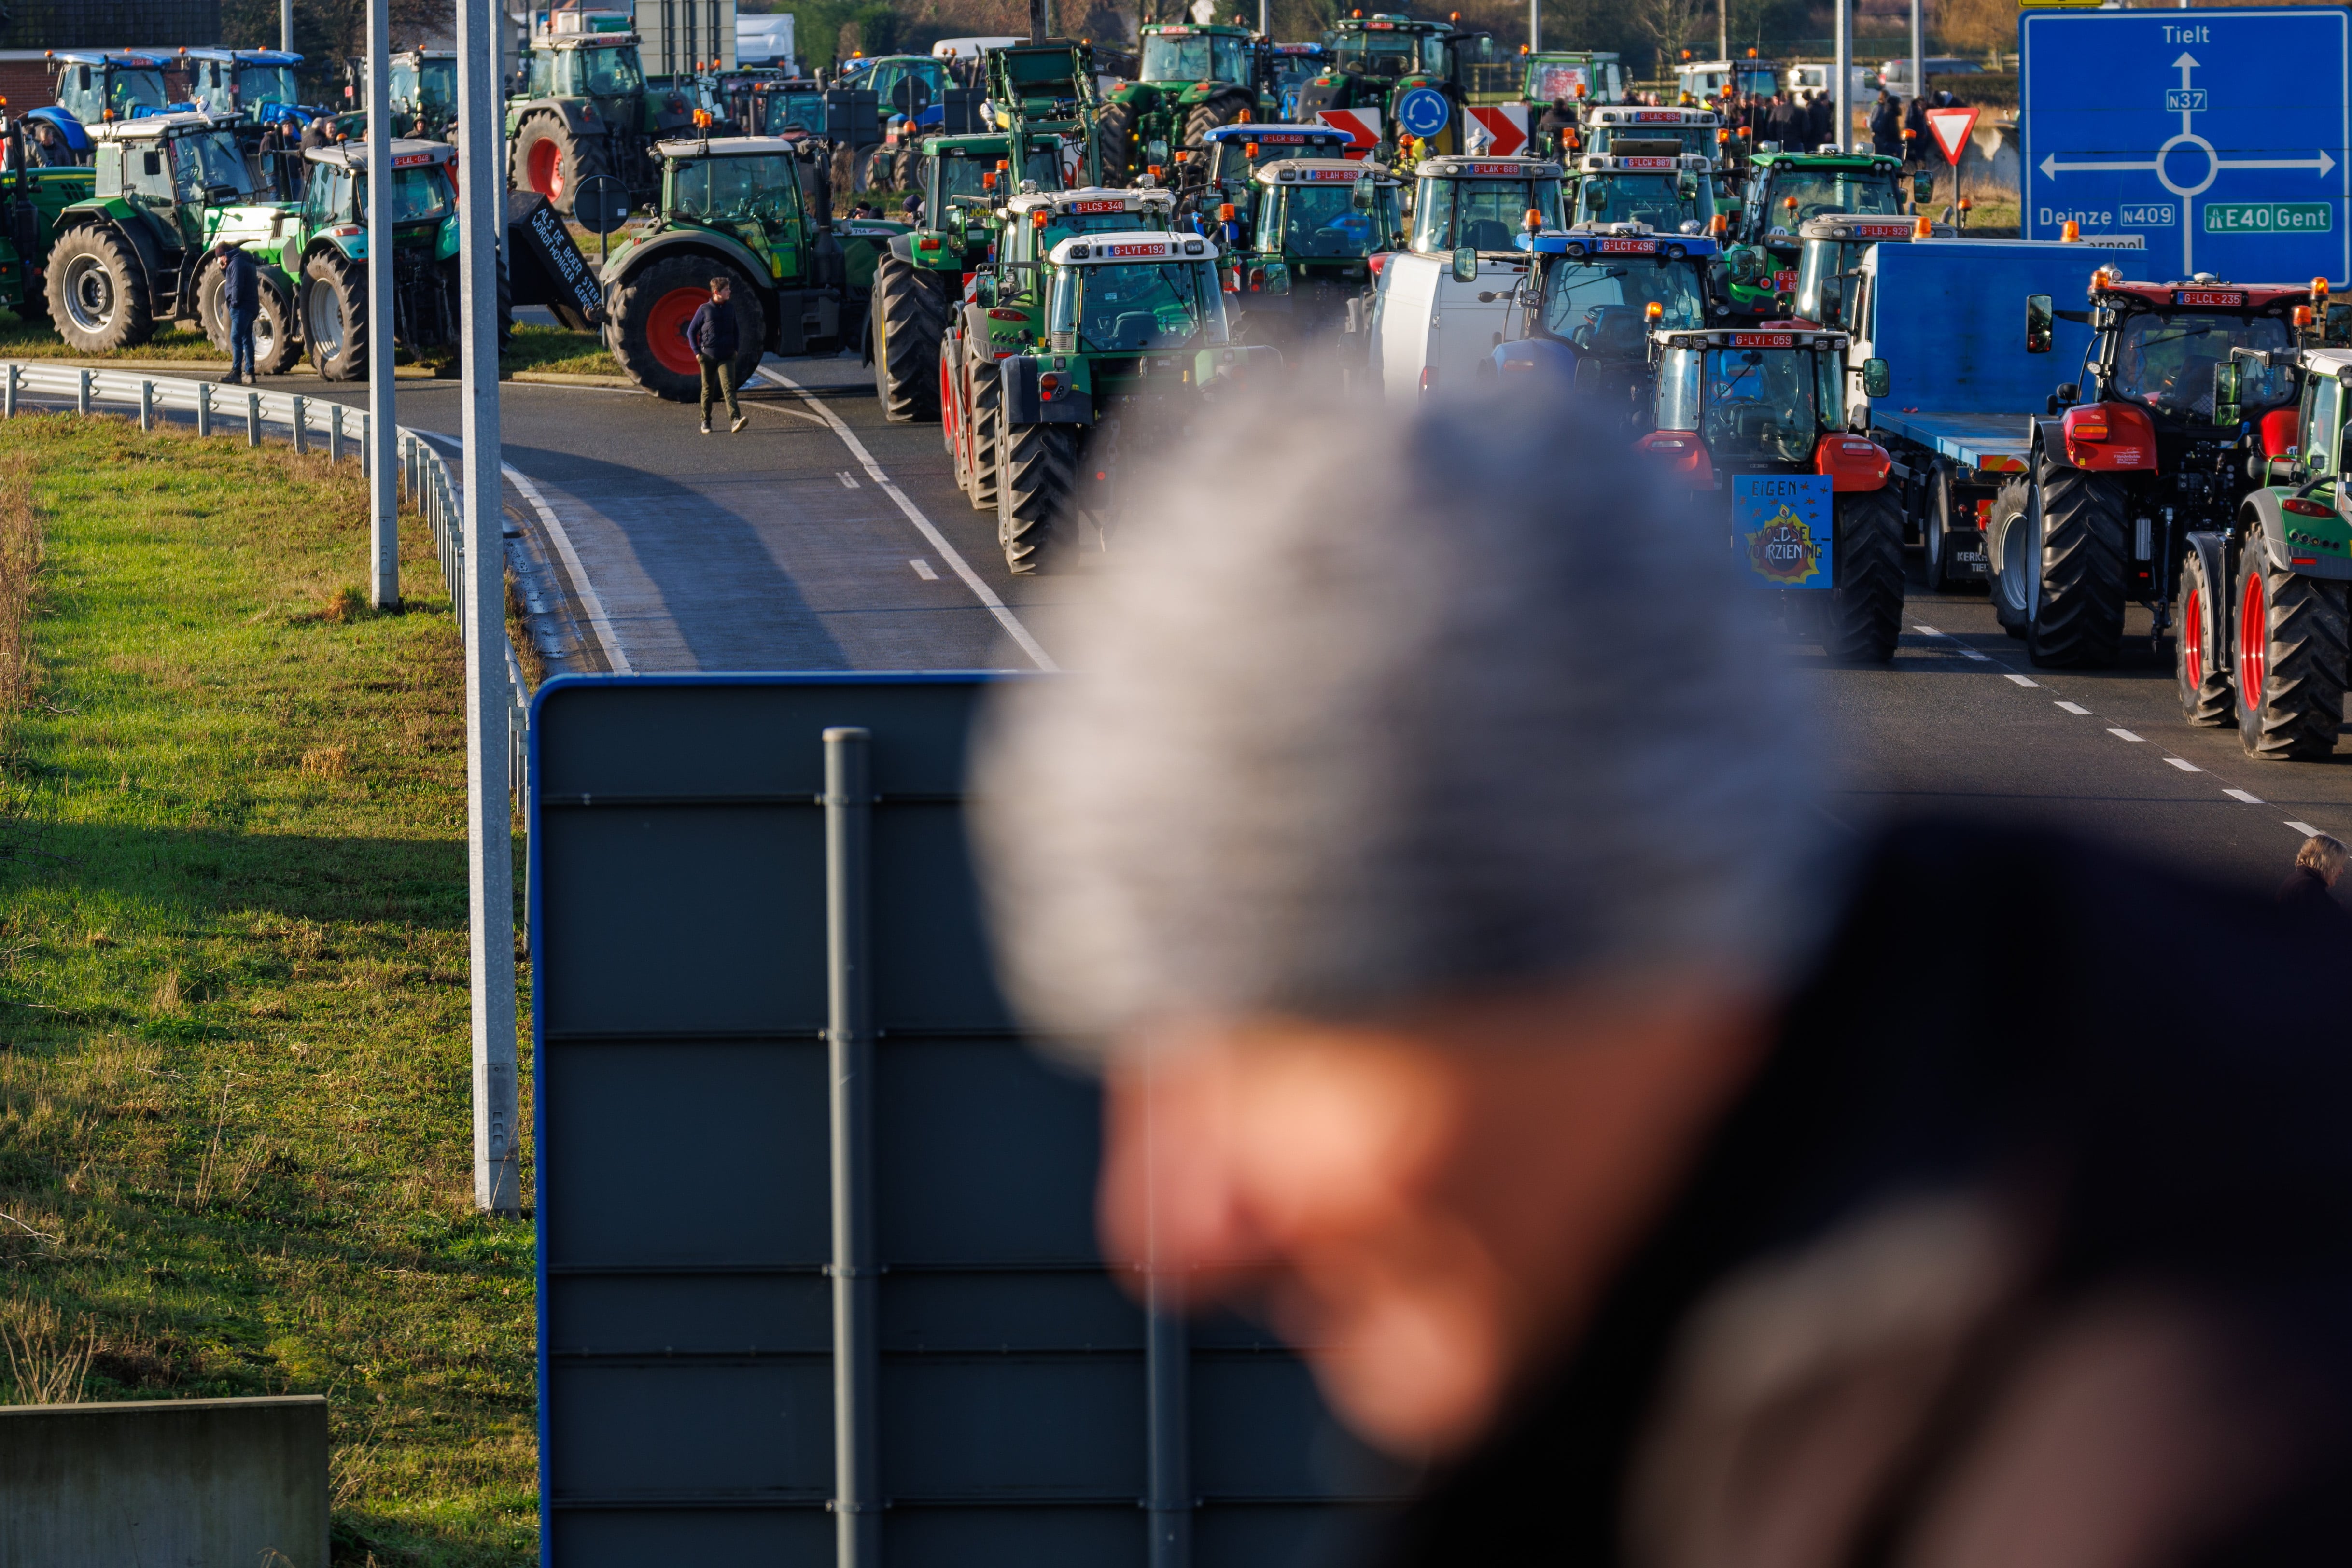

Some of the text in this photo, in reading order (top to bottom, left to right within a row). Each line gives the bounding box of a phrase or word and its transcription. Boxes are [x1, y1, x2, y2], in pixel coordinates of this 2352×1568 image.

[2162, 26, 2210, 43] Tielt
[2170, 92, 2203, 108] N37
[395, 154, 429, 165] G-LAL-048
[1474, 165, 1518, 173] G-LAK-688
[1077, 201, 1123, 211] G-LCS-340
[969, 208, 989, 217] JOH
[2040, 207, 2172, 225] Deinze N409
[2226, 208, 2326, 227] E40 Gent
[1862, 227, 1908, 236] G-LBJ-929
[538, 208, 554, 229] ALS
[553, 229, 564, 246] DE
[563, 246, 583, 276] BOER
[1604, 241, 1654, 251] G-LCT-496
[532, 215, 553, 247] WORDT
[549, 243, 575, 284] HONGER
[1114, 245, 1164, 255] G-LYT-192
[2184, 294, 2240, 304] G-LCL-235
[1736, 336, 1792, 345] G-LYI-059
[1971, 563, 1989, 572] TIEL
